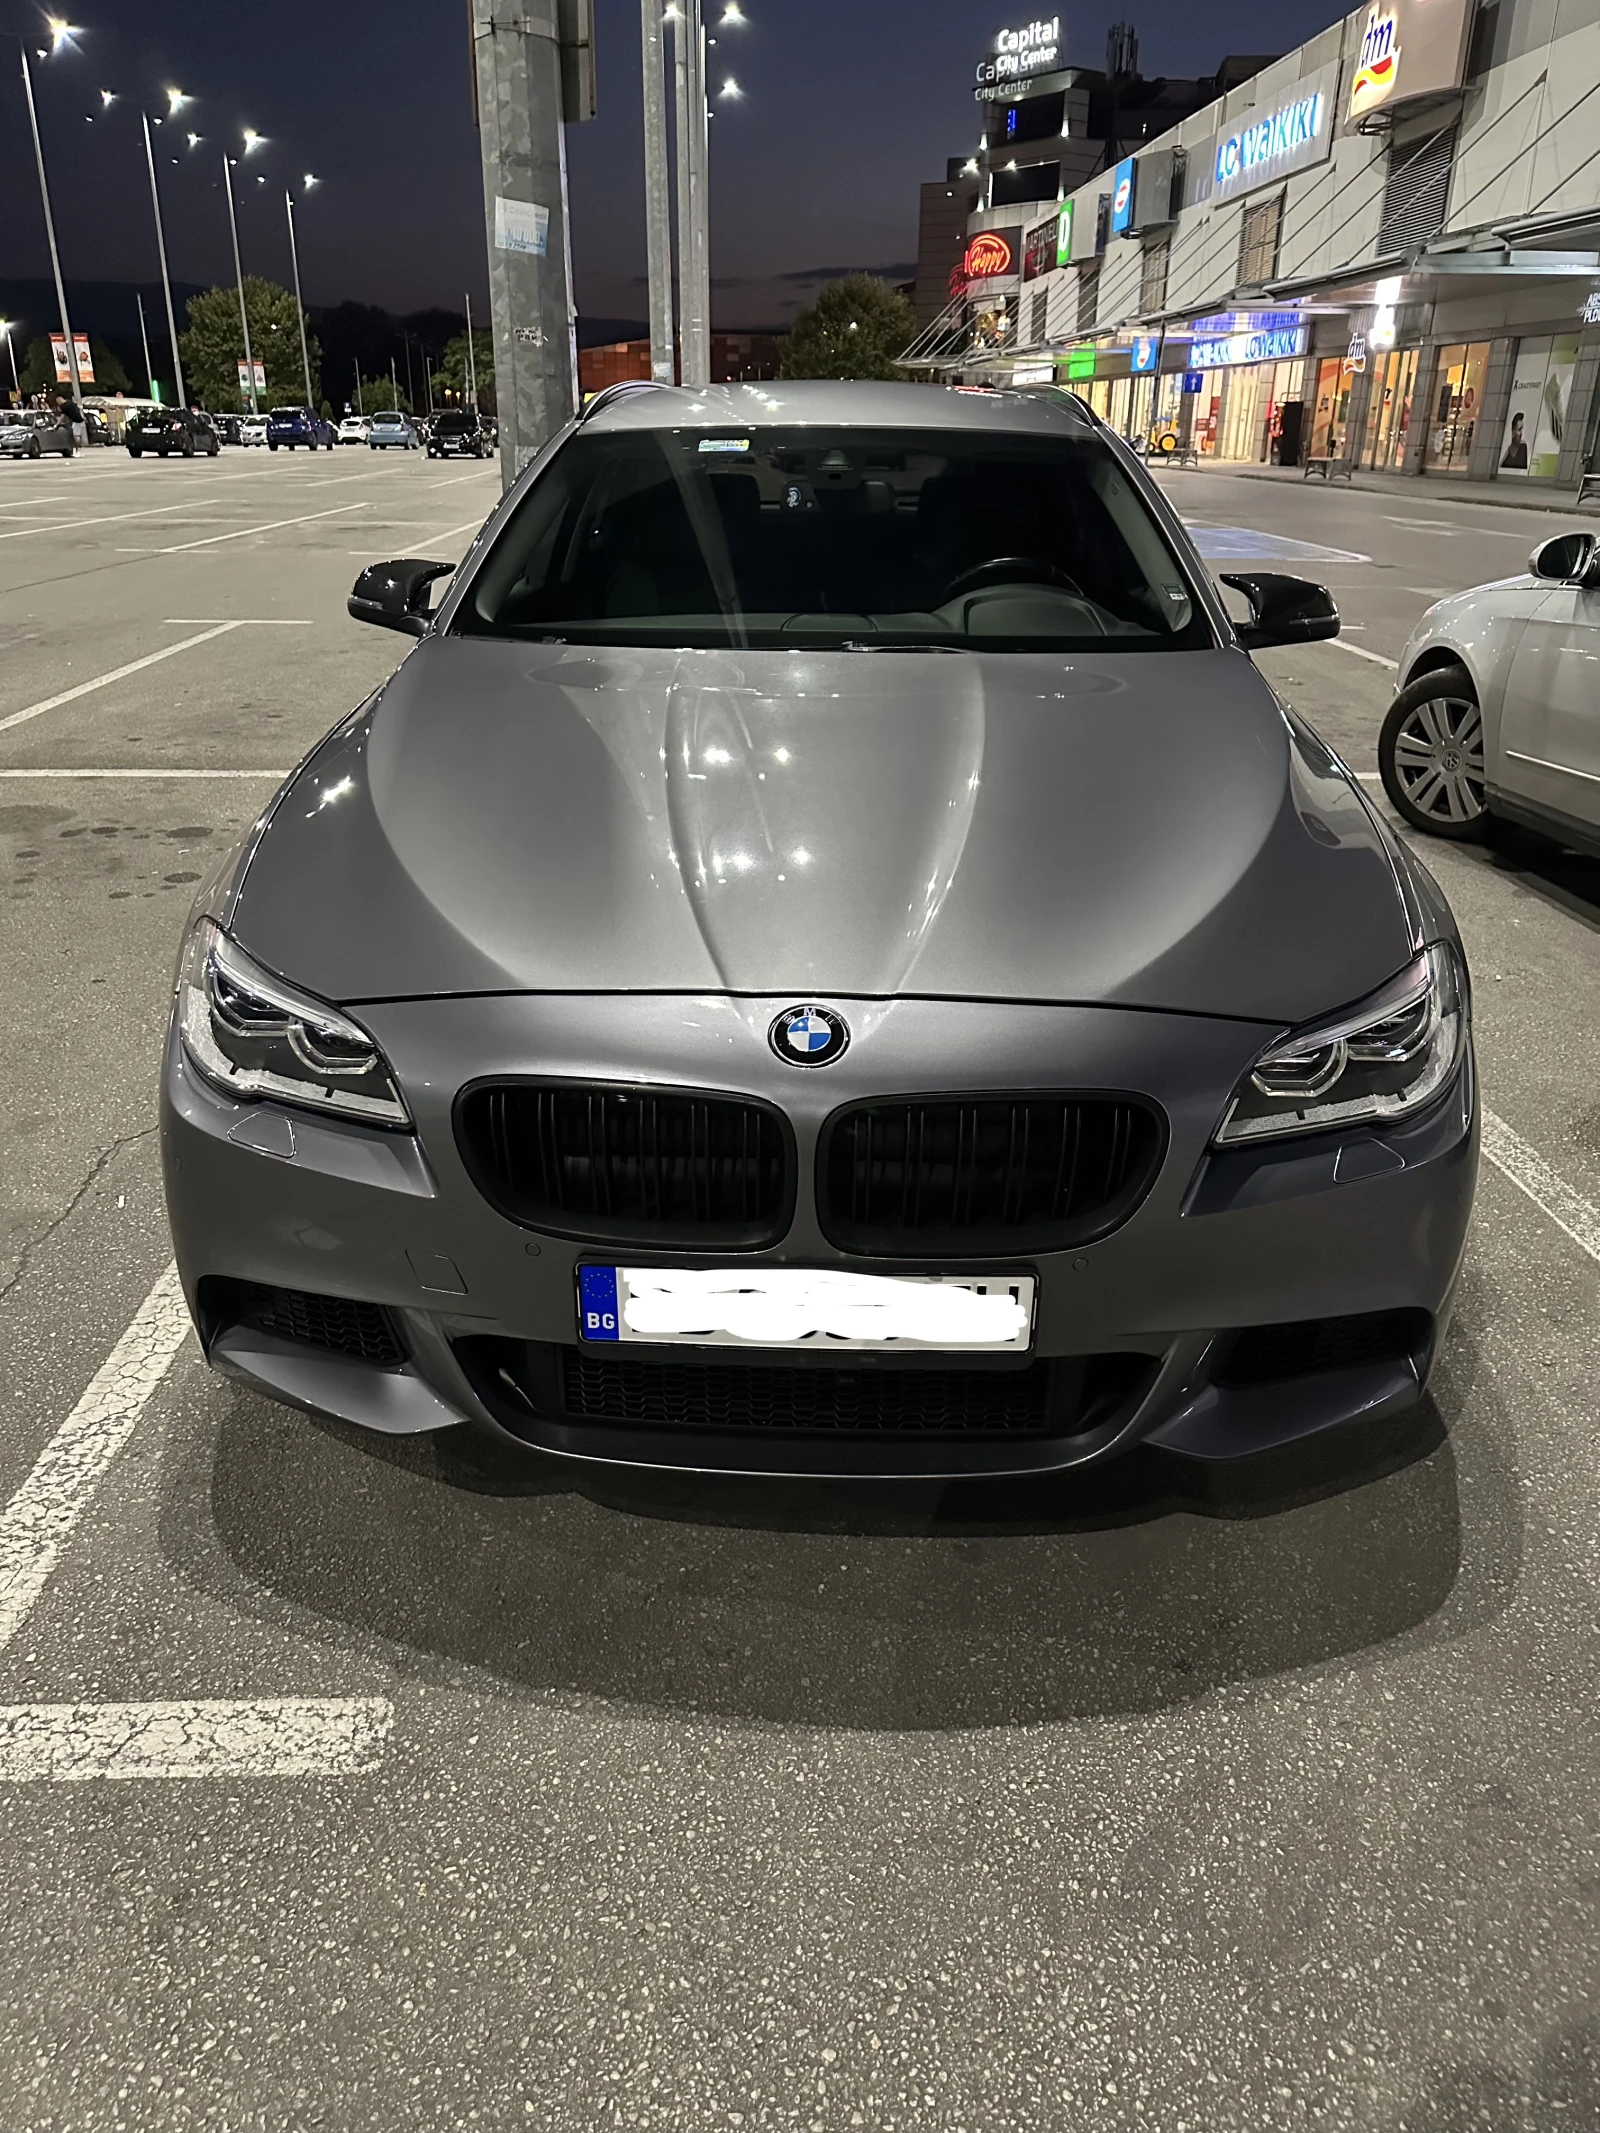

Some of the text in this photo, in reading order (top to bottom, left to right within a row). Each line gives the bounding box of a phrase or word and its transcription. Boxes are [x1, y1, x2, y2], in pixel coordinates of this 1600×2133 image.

[998, 16, 1059, 53] Capital
[1361, 13, 1393, 68] dm
[996, 54, 1018, 73] City
[1021, 46, 1058, 66] Center
[1215, 137, 1240, 184] LC
[971, 245, 1005, 275] Happy
[1348, 334, 1365, 359] dm
[587, 1312, 616, 1330] BG
